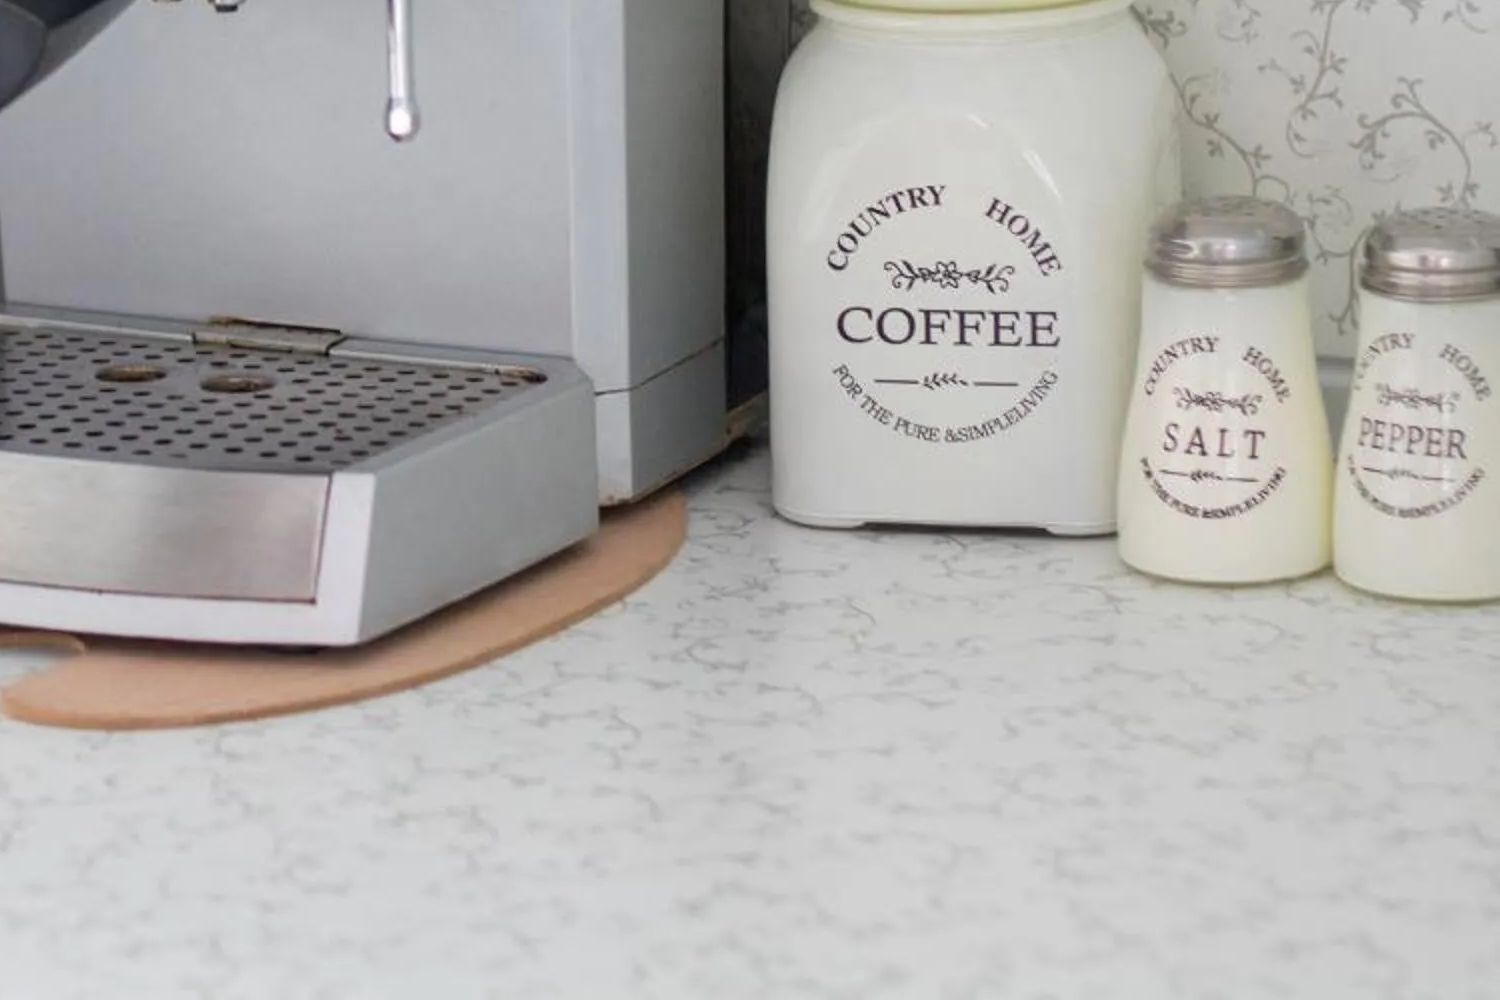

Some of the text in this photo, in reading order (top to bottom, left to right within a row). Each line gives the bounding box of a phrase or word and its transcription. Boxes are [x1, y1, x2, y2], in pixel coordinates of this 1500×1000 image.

[827, 184, 1063, 277] COUNTRY HOME
[836, 306, 1061, 348] COFFEE
[1242, 346, 1291, 404] HOME
[1438, 343, 1492, 402] HOME
[832, 364, 864, 401] FOR
[860, 395, 894, 426] THE
[893, 417, 941, 443] PURE
[1162, 422, 1266, 460] SALT
[1357, 416, 1467, 460] PEPPER
